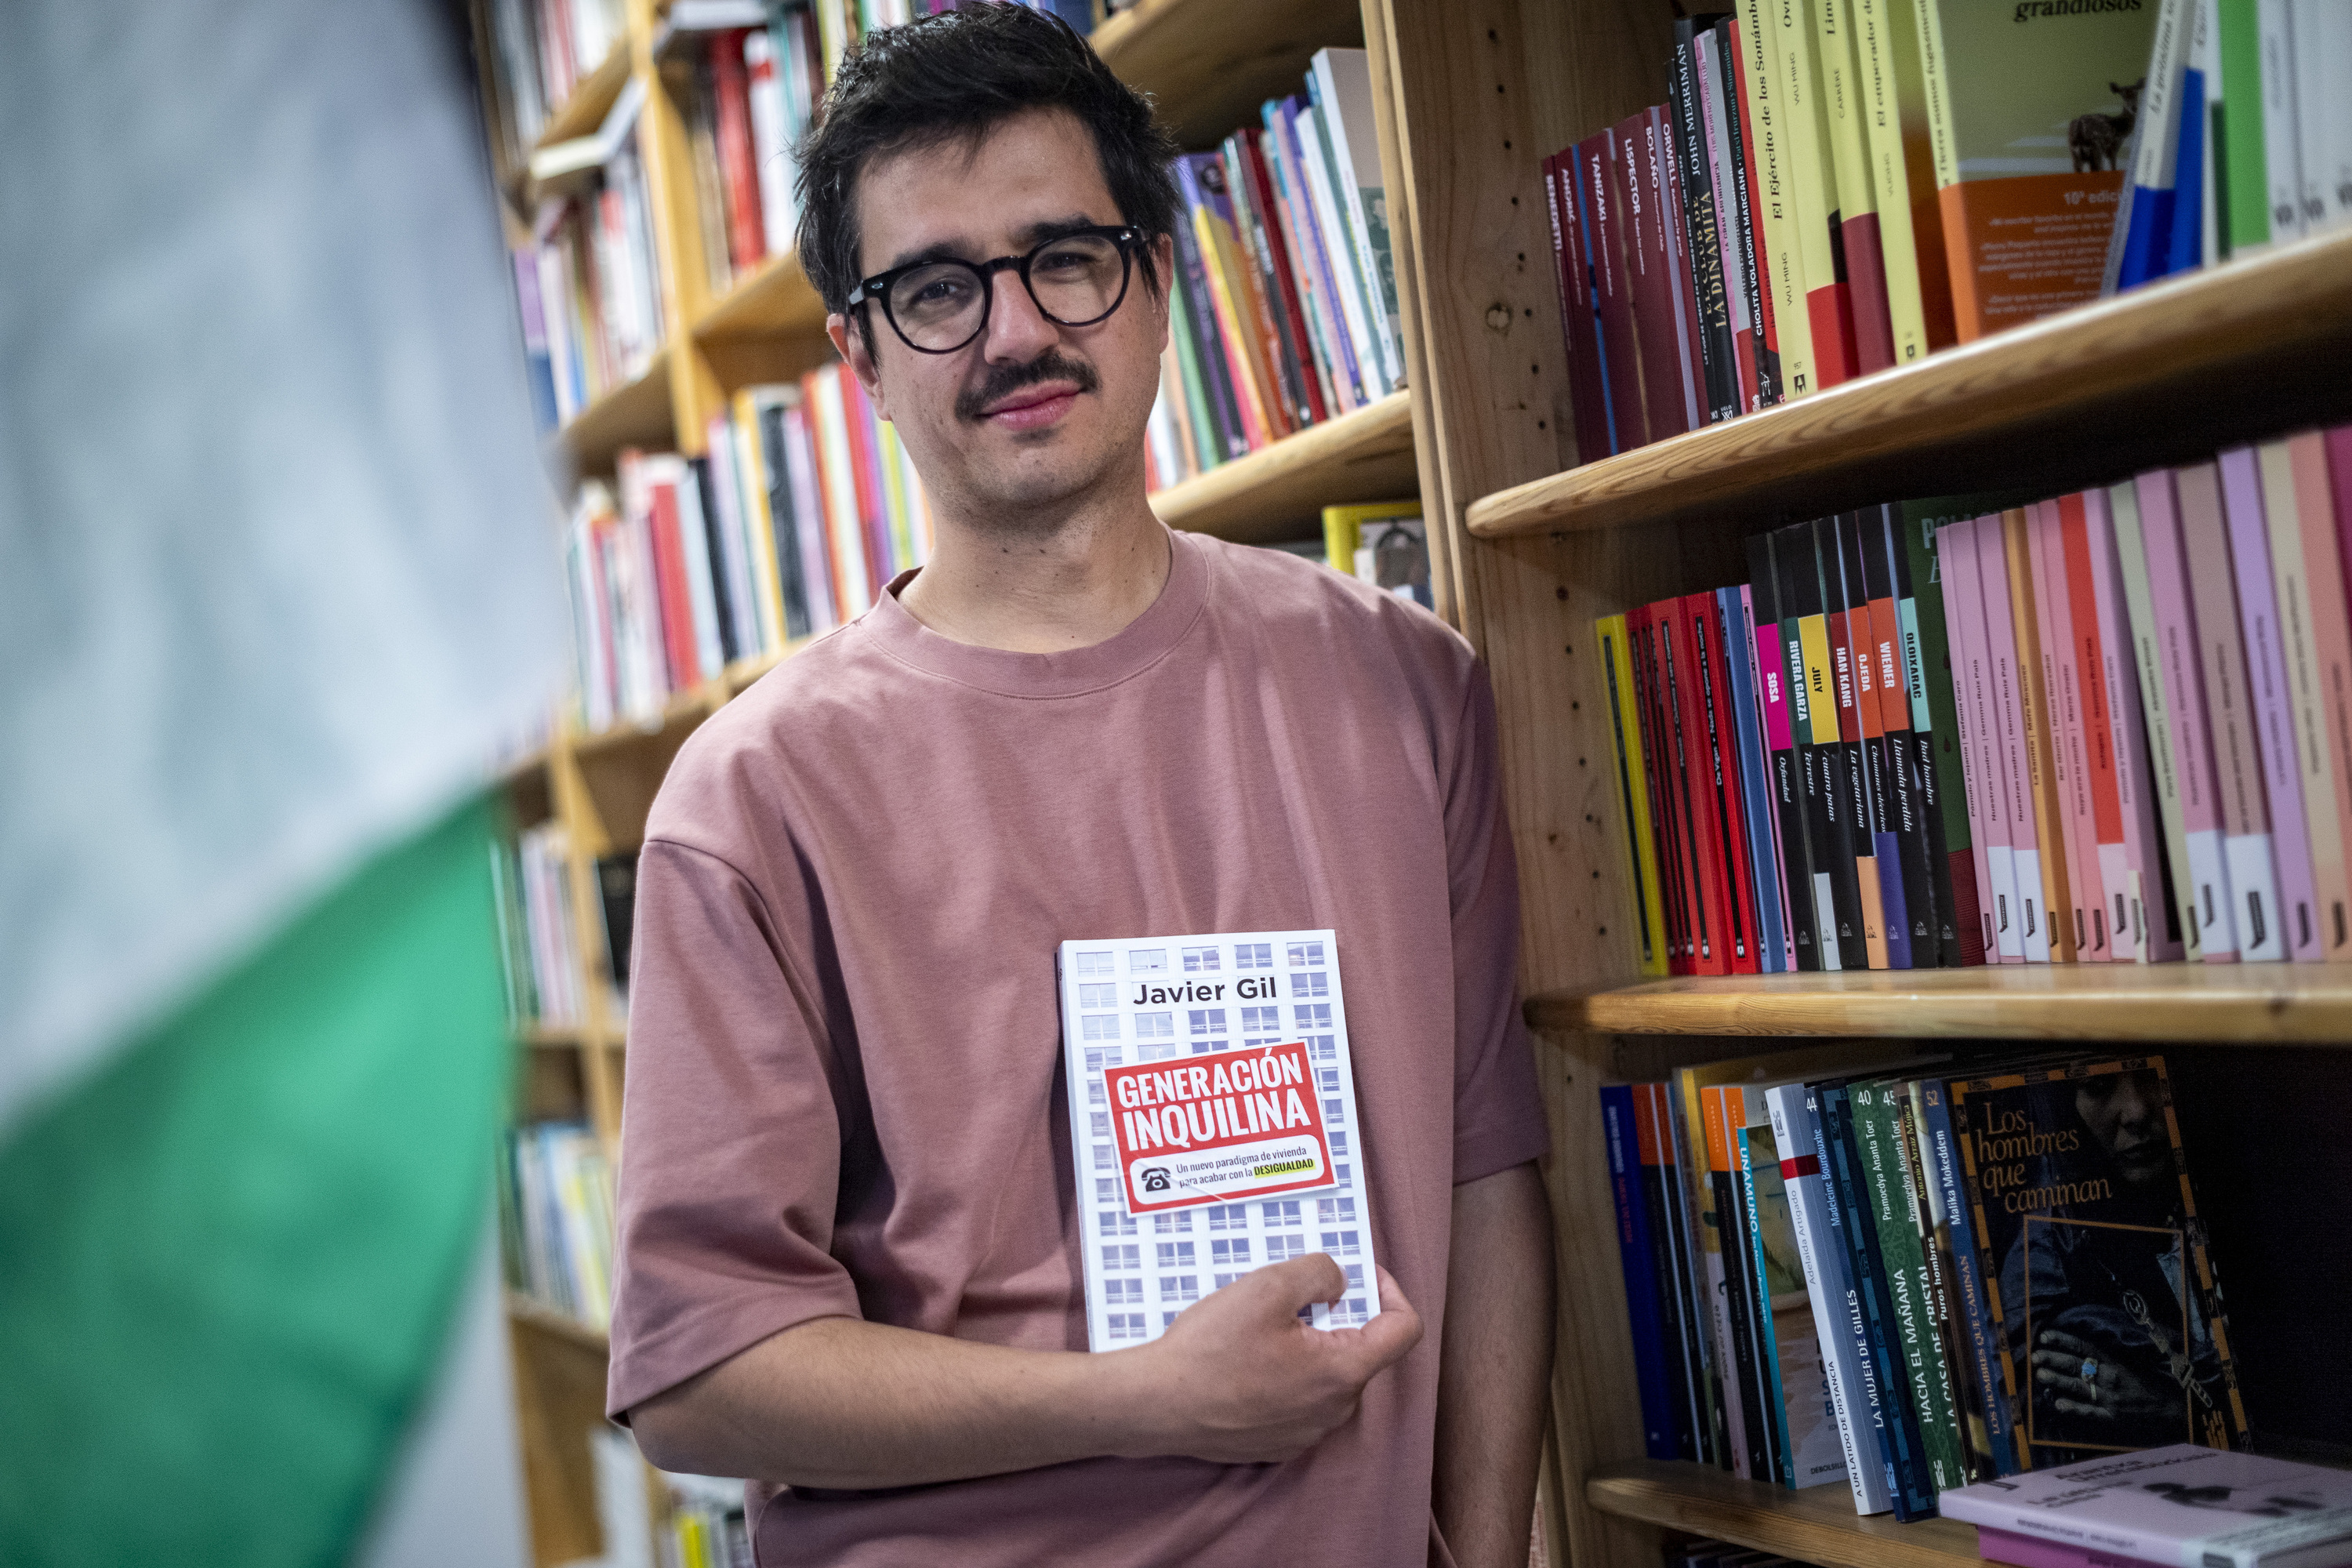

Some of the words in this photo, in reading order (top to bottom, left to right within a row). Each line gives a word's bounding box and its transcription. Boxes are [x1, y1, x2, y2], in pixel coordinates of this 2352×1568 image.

[1724, 42, 1733, 90] Simonides
[1676, 43, 1695, 132] MERRIMAN
[1757, 75, 1769, 100] los
[1793, 85, 1800, 106] WU
[1760, 106, 1771, 126] de
[1646, 126, 1659, 189] BOLAÑO
[1663, 123, 1676, 187] ORWELL
[1688, 135, 1701, 176] JOHN
[1765, 132, 1780, 196] Ejército
[1591, 154, 1607, 221] TANIZAKI
[1624, 139, 1641, 215] LISPECTOR
[1738, 168, 1750, 225] MARCIANA
[1545, 174, 1562, 250] BENEDETTI
[1771, 203, 1783, 220] El
[1700, 191, 1723, 295] DINAMITA
[1744, 228, 1757, 287] VOLADORA
[1781, 252, 1791, 282] MING
[1714, 300, 1727, 328] LA
[1751, 289, 1762, 336] CHOLITA
[1785, 285, 1793, 306] WU
[1789, 641, 1802, 682] RIVERA
[1811, 666, 1823, 693] JULY
[1836, 648, 1847, 673] HAN
[1879, 641, 1895, 688] WIENER
[1906, 633, 1922, 699] OLOIXARAC
[1707, 699, 1711, 708] se
[1794, 684, 1807, 721] GARZA
[1839, 675, 1852, 708] KANG
[2005, 700, 2013, 735] Gemma
[1766, 672, 1779, 703] SOSA
[1778, 757, 1791, 803] Orfandad
[1849, 750, 1857, 764] La
[1858, 654, 1871, 692] OJEDA
[1871, 745, 1881, 792] Chamanes
[1876, 793, 1886, 833] eléctricos
[1920, 739, 1930, 763] Bad
[1715, 771, 1722, 786] De
[1804, 751, 1816, 796] Terrestre
[1822, 757, 1832, 791] cuatro
[1893, 739, 1906, 787] Llamada
[2010, 745, 2019, 779] madres
[1851, 767, 1864, 829] vegetariana
[1923, 764, 1934, 805] hombre
[1988, 781, 1997, 822] Nuestras
[2015, 781, 2024, 822] Nuestras
[1824, 792, 1835, 822] patas
[1898, 789, 1912, 833] perdida
[1134, 982, 1225, 1004] Javier
[1236, 977, 1277, 999] Gil
[1116, 1048, 1304, 1109] GENERACIÓN
[1857, 1090, 1871, 1105] 40
[1806, 1097, 1817, 1112] 44
[1926, 1090, 1940, 1107] 52
[1123, 1087, 1312, 1151] INQUILINA
[1865, 1120, 1876, 1139] Toer
[1891, 1120, 1900, 1139] Toer
[1904, 1105, 1914, 1134] Mújica
[1984, 1102, 2026, 1135] Los
[1176, 1163, 1188, 1174] Un
[1190, 1161, 1214, 1171] nuevo
[1215, 1154, 1259, 1171] paradigma
[1261, 1152, 1271, 1160] de
[1272, 1146, 1306, 1159] vivienda
[1813, 1129, 1831, 1180] Bourdouxhe
[1869, 1140, 1882, 1171] Ananta
[1895, 1141, 1908, 1172] Ananta
[1936, 1130, 1954, 1187] Mokeddem
[1976, 1122, 2079, 1162] hombres
[1179, 1178, 1198, 1188] para
[1200, 1173, 1226, 1184] acabar
[1229, 1171, 1243, 1180] con
[1254, 1159, 1314, 1176] DESIGUALDAD
[1740, 1147, 1758, 1232] UNAMUNO
[1914, 1164, 1926, 1200] Antonio
[1984, 1163, 2026, 1197] que
[1790, 1190, 1806, 1236] Artigado
[1825, 1181, 1841, 1227] Madeleine
[1876, 1174, 1892, 1221] Pramoedya
[1902, 1174, 1917, 1221] Pramoedya
[1947, 1190, 1961, 1225] Malika
[2005, 1175, 2114, 1214] caminan
[1802, 1239, 1816, 1285] Adelaida
[1928, 1236, 1942, 1285] hombres
[1937, 1288, 1948, 1320] Puros
[1959, 1255, 1978, 1316] CAMINAN
[1846, 1290, 1863, 1334] GILLES
[1893, 1269, 1918, 1344] MAÑANA
[1857, 1338, 1869, 1356] DE
[1973, 1319, 1984, 1345] QUE
[1910, 1348, 1922, 1367] EL
[1828, 1361, 1845, 1414] DISTANCIA
[1862, 1359, 1878, 1406] MUJER
[1979, 1348, 1995, 1407] HOMBRES
[1915, 1372, 1934, 1423] HACIA
[1840, 1417, 1848, 1430] DE
[1873, 1410, 1884, 1428] LA
[1990, 1411, 2001, 1434] LOS
[1844, 1433, 1857, 1469] LATIDO
[1852, 1472, 1860, 1487] UN
